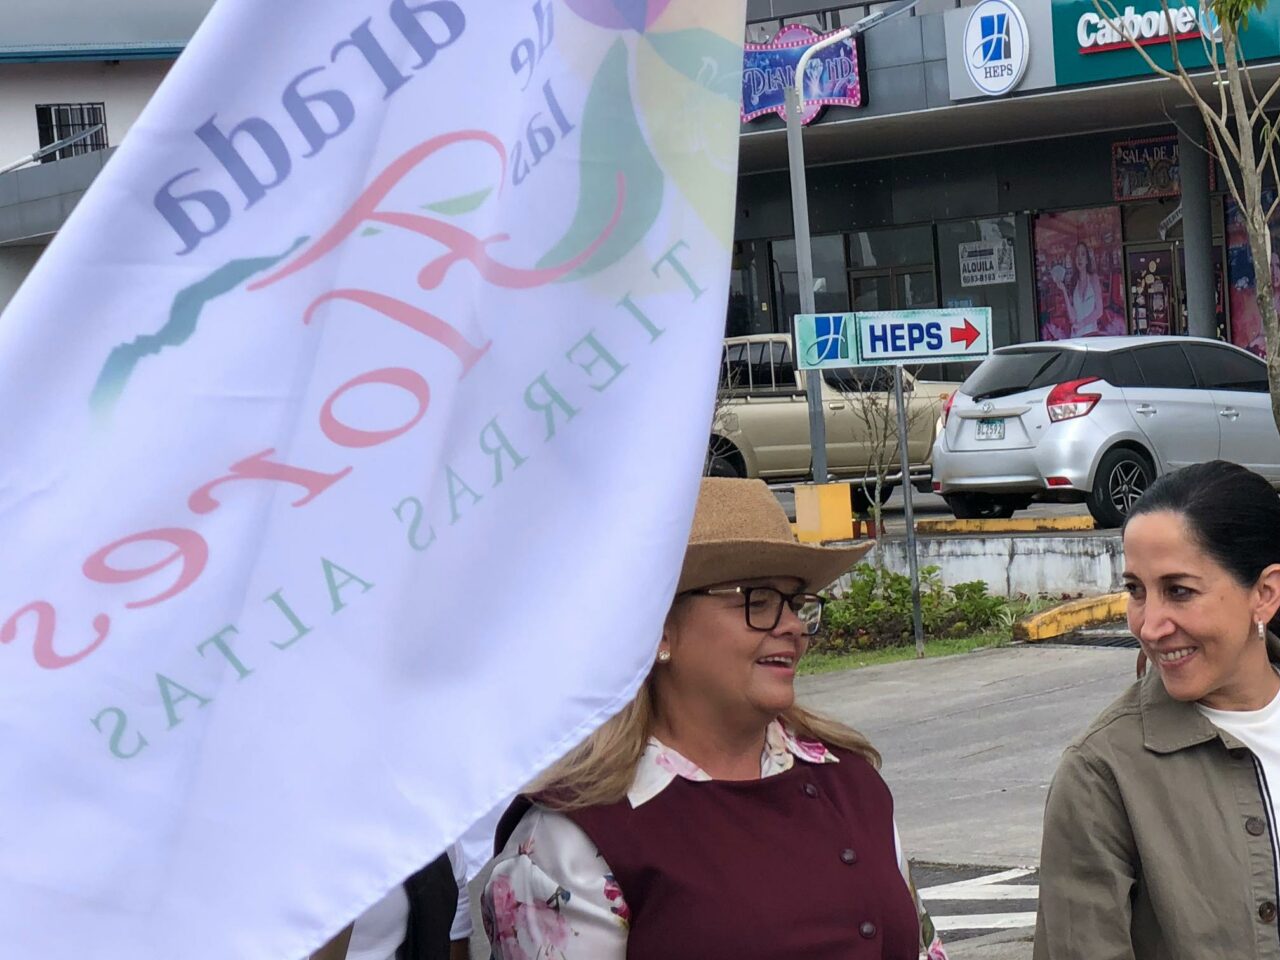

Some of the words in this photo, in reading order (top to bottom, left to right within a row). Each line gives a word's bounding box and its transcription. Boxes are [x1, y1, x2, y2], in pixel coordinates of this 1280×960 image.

[984, 64, 1013, 79] HEPS
[1122, 148, 1149, 164] SALA
[1153, 145, 1167, 160] DE
[869, 322, 943, 352] HEPS
